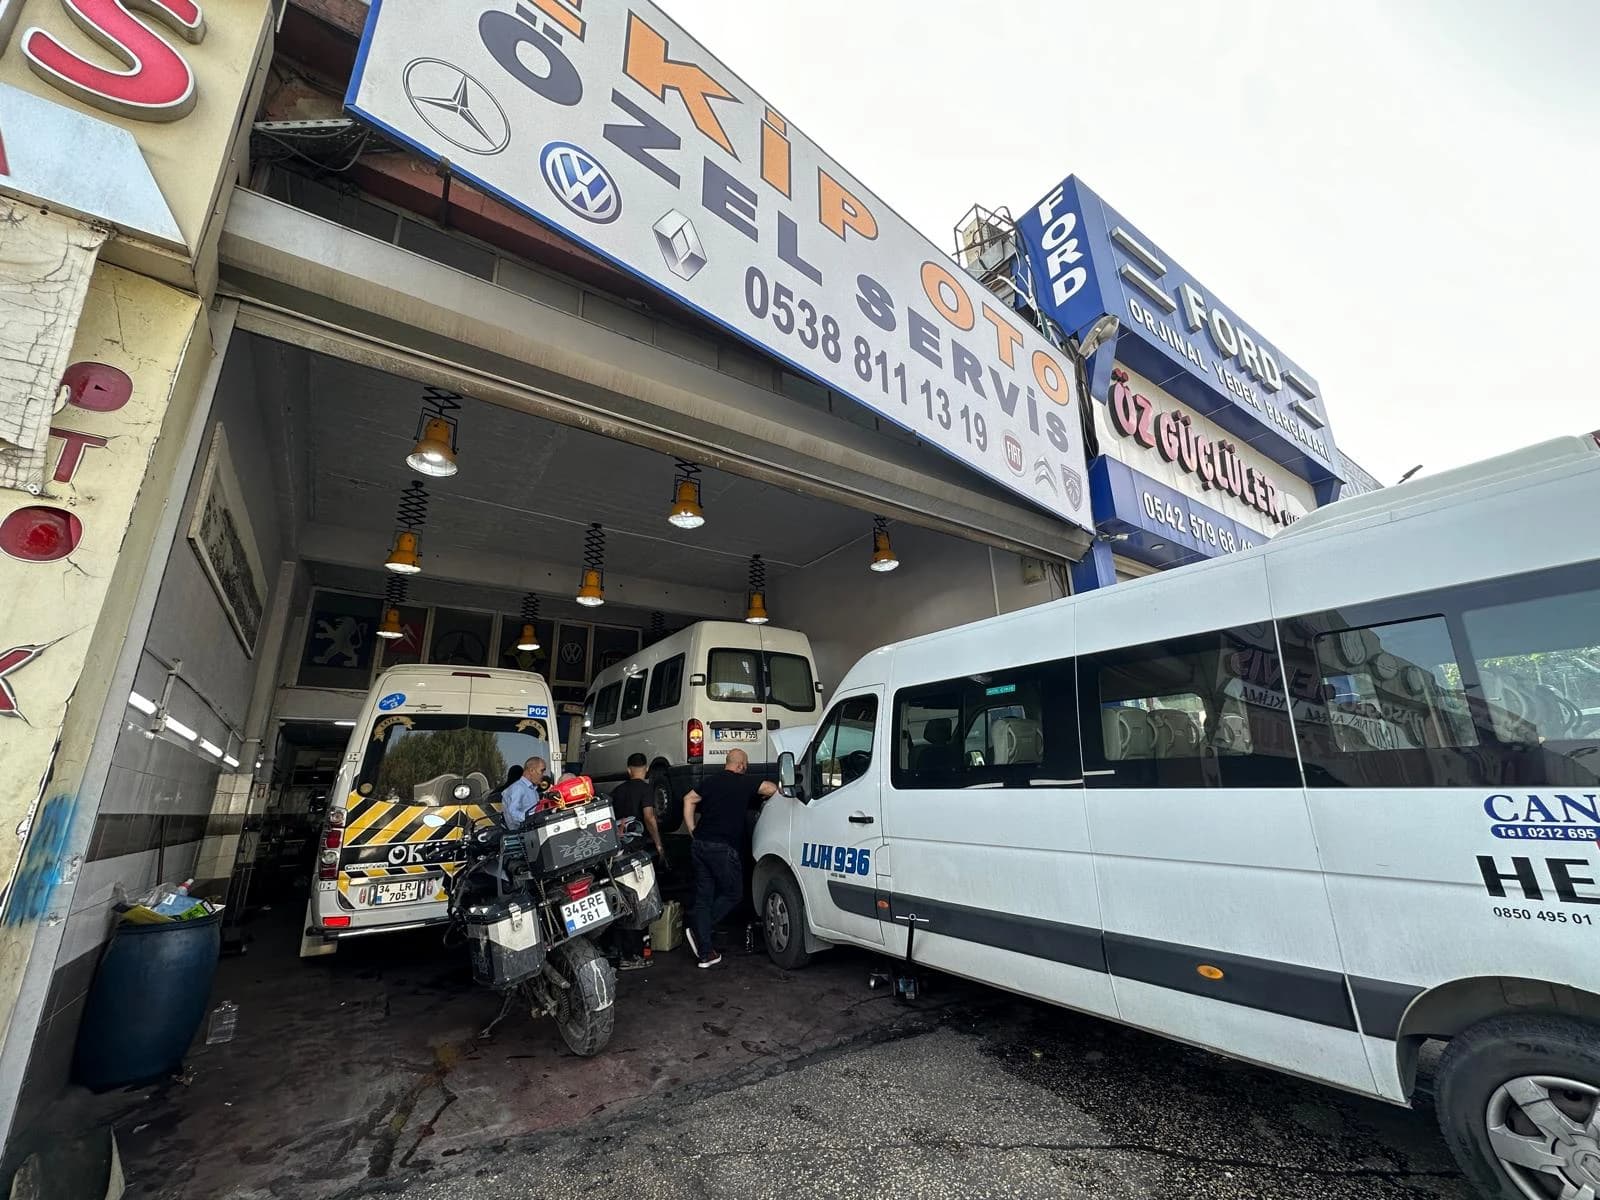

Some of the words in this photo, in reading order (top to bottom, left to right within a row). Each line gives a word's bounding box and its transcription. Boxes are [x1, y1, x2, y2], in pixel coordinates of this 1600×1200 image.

[478, 3, 823, 287] ÖZEL
[855, 273, 1069, 453] SERVİS
[1038, 185, 1087, 308] FORD
[744, 265, 842, 363] 0538
[853, 335, 908, 405] 811
[920, 378, 952, 431] 13
[960, 403, 988, 452] 19
[919, 260, 1070, 406] OTO
[1178, 283, 1283, 394] FORD
[1212, 360, 1262, 413] YEDEK
[1108, 368, 1156, 449] ÖZ
[1155, 409, 1281, 524] GÜÇLÜLER
[1143, 491, 1187, 533] 0542
[1189, 513, 1217, 546] 579
[1218, 527, 1237, 553] 68
[529, 707, 547, 716] P02
[801, 842, 834, 871] LUH
[833, 846, 871, 877] 936
[1567, 828, 1597, 839] 695
[378, 885, 391, 894] 34
[399, 882, 418, 892] LRJ
[389, 892, 407, 902] 705
[580, 909, 601, 924] 361
[1493, 906, 1532, 920] 0850
[1536, 910, 1568, 924] 495
[1572, 913, 1593, 926] 01
